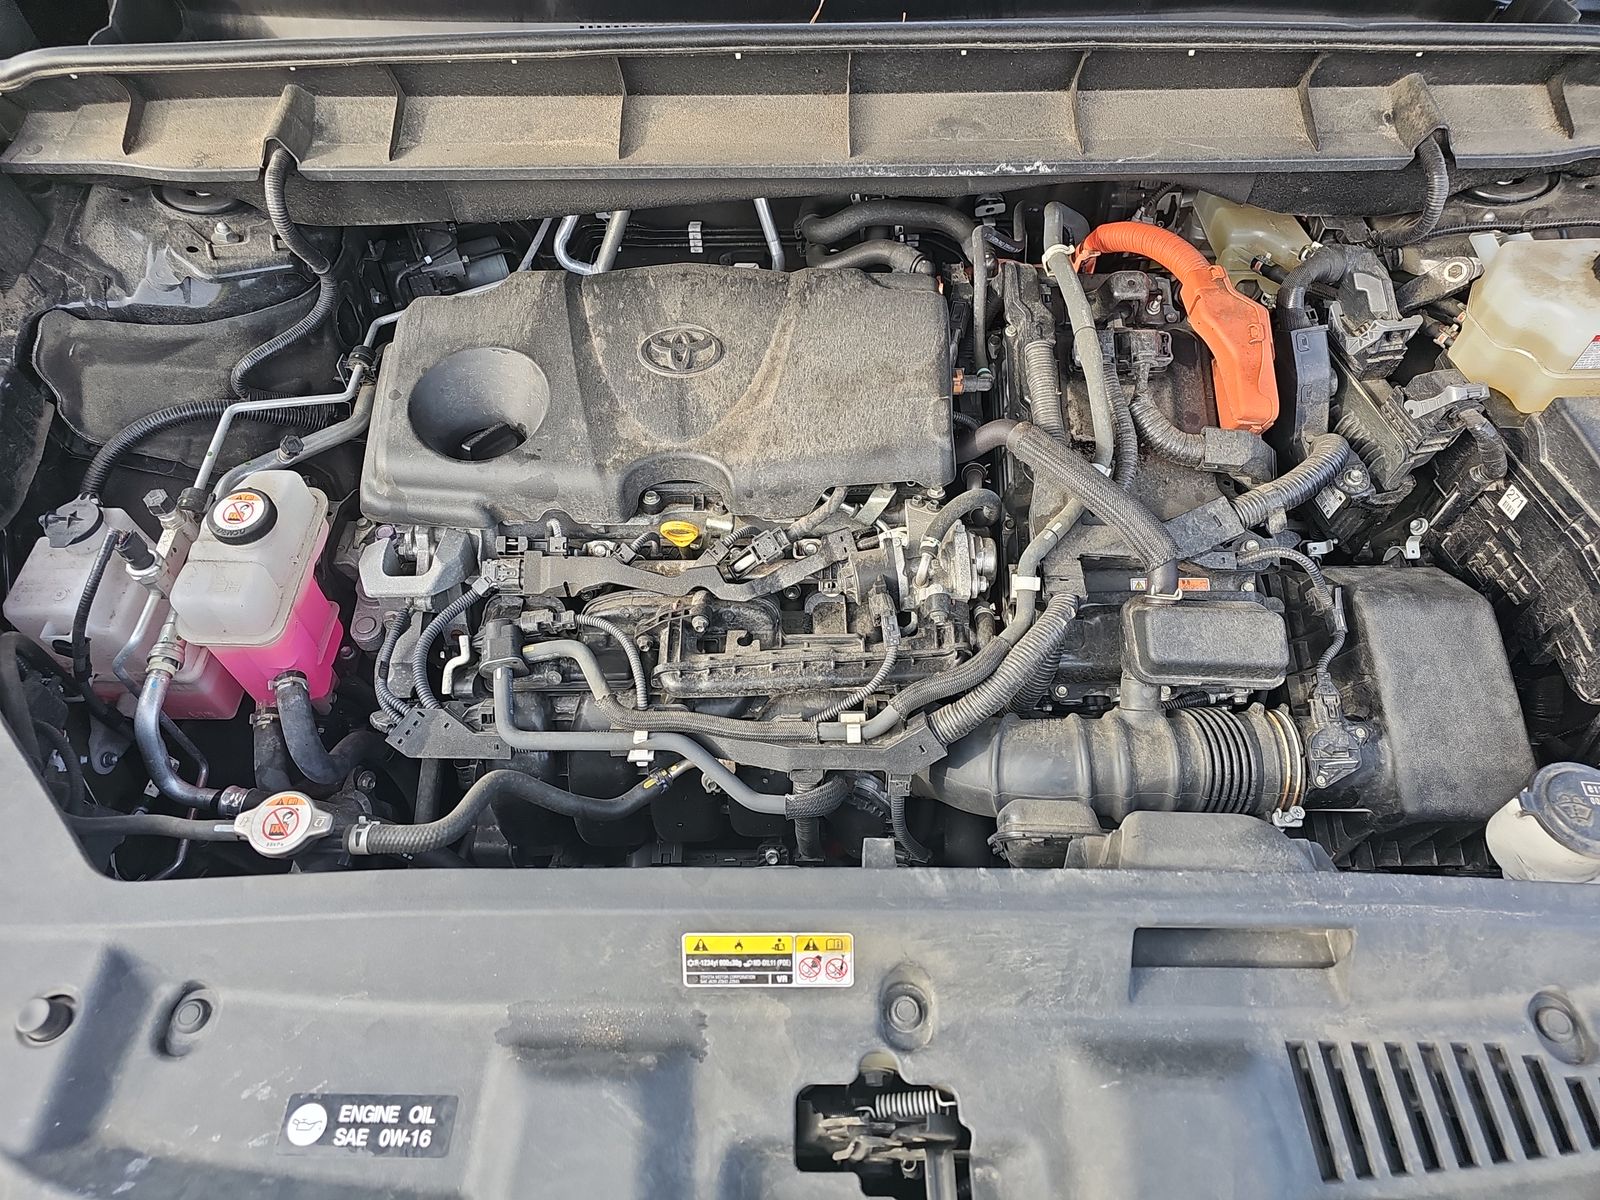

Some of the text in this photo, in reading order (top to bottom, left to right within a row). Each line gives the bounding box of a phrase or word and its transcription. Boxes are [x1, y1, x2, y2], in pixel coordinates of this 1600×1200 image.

[1506, 488, 1525, 509] 271
[338, 1104, 436, 1124] ENGINE OIL
[333, 1128, 432, 1148] SAE 0W-16
